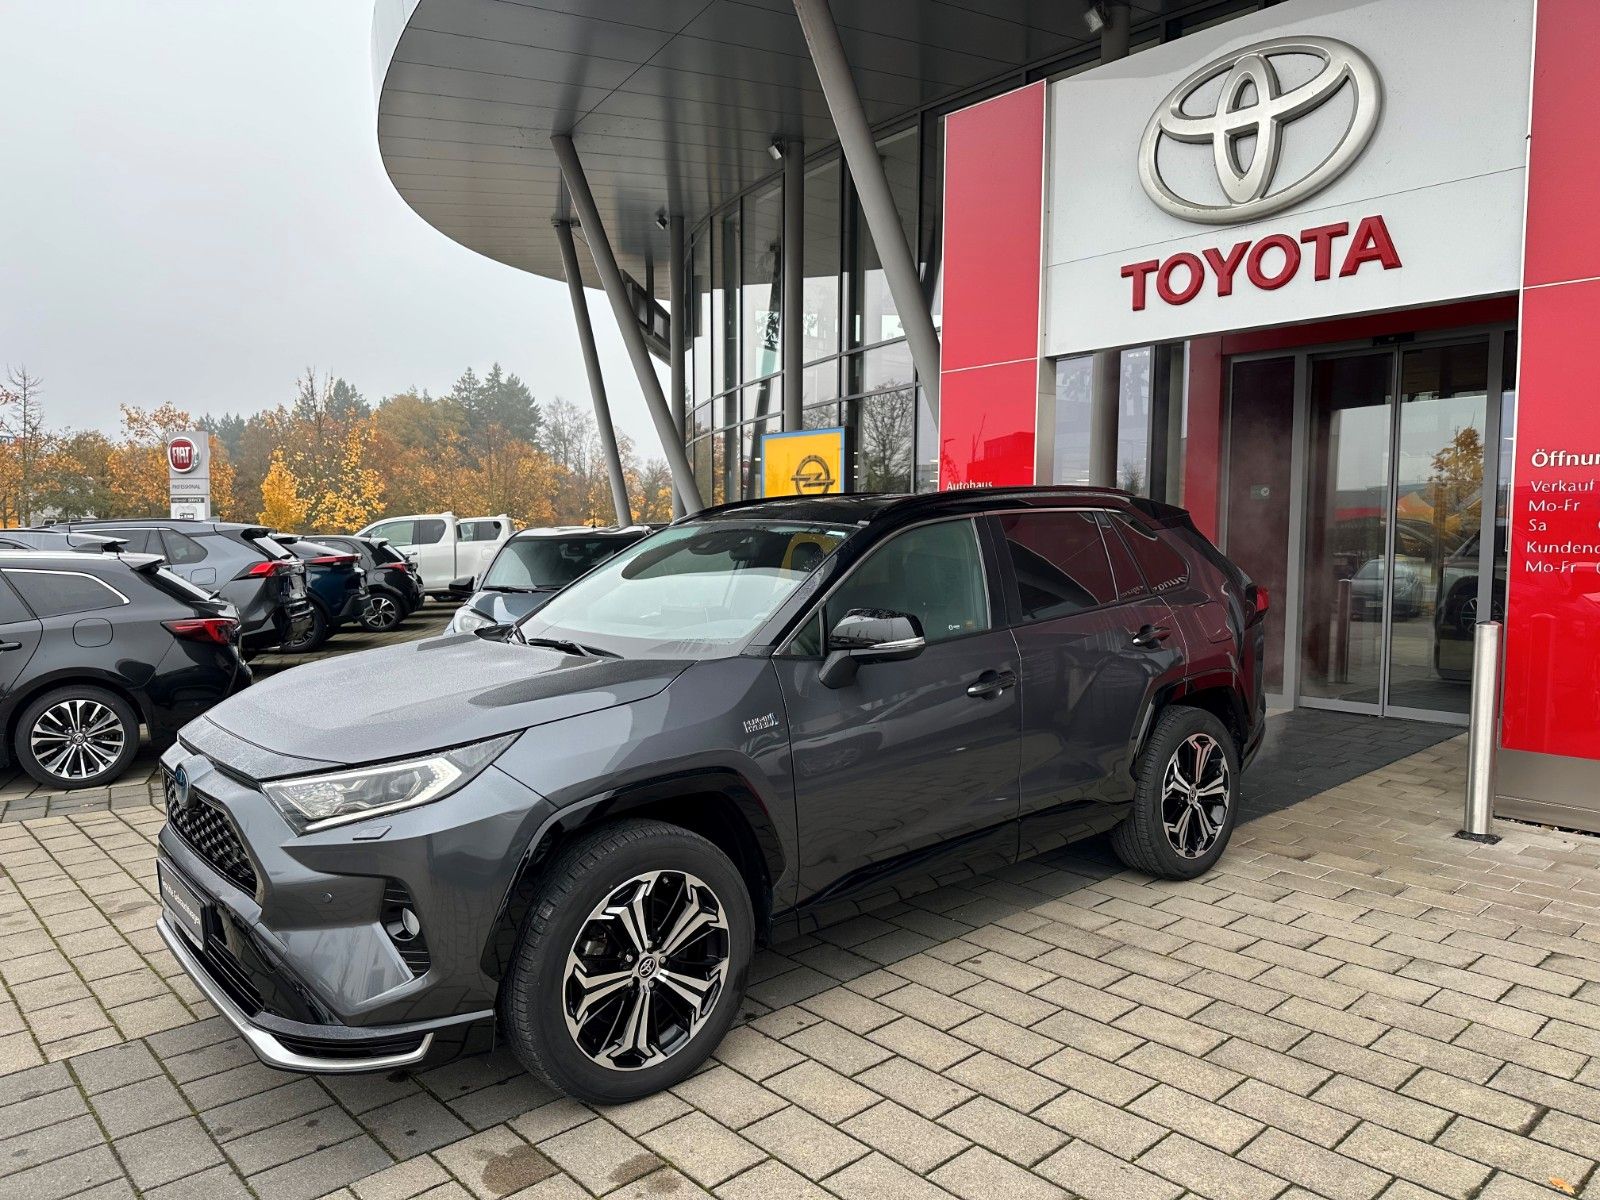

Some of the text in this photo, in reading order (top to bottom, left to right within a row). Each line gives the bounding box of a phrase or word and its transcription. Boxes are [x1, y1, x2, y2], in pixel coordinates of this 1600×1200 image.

[1121, 214, 1402, 311] TOYOTA
[171, 446, 191, 464] FIAT
[946, 479, 993, 491] Autohaus
[1530, 478, 1595, 493] Verkauf
[1528, 498, 1581, 512] Mo-Fr
[1528, 518, 1547, 532] Sa
[1525, 560, 1577, 574] Mo-Fr
